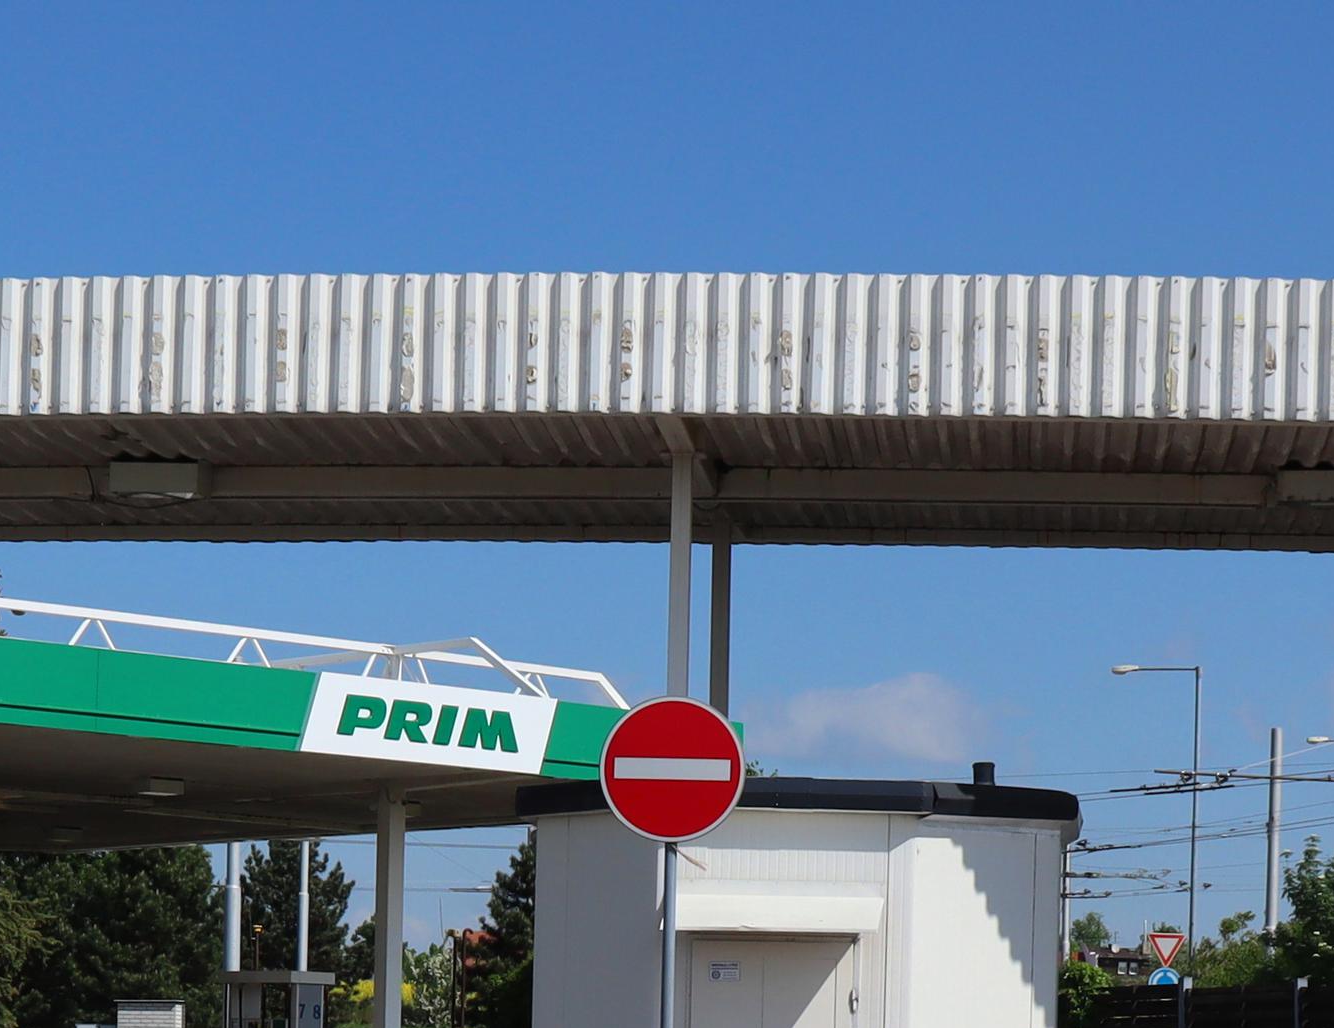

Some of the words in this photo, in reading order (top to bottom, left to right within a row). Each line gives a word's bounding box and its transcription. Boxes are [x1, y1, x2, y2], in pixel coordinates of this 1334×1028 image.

[336, 693, 519, 753] PRIM
[299, 1003, 306, 1019] 7
[313, 1004, 321, 1020] 8
